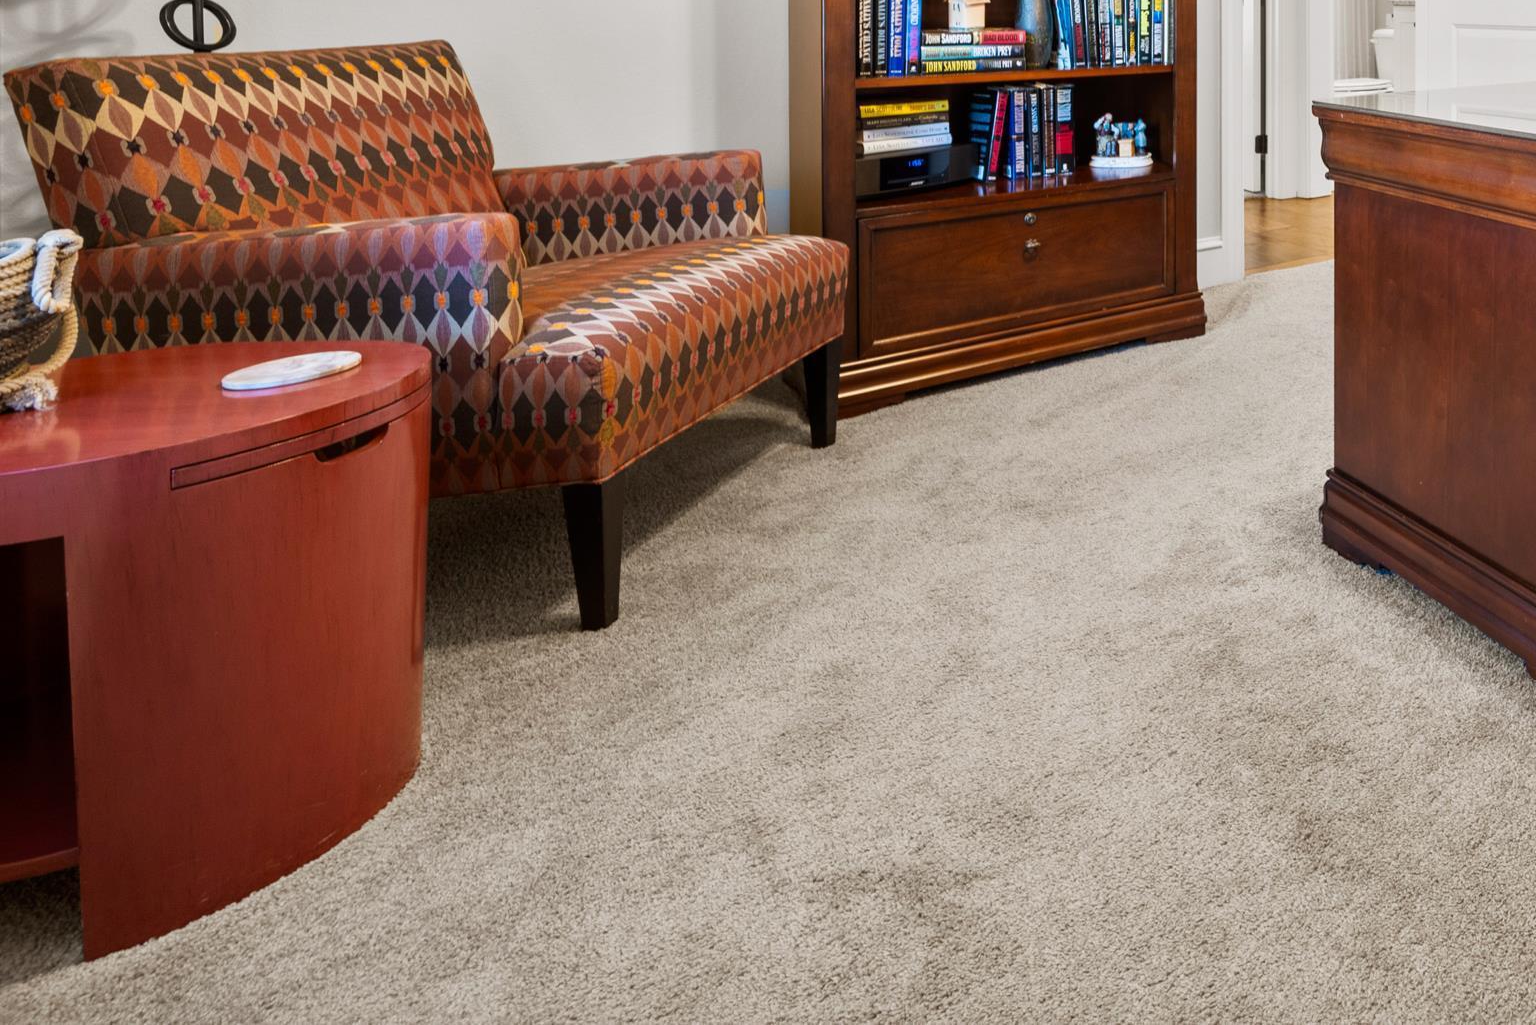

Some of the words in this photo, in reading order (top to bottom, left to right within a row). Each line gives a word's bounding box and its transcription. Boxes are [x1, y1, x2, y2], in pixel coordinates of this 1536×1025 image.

[926, 33, 940, 44] JOHN
[941, 33, 972, 44] SANDFORD
[926, 61, 942, 73] JOHN
[944, 60, 976, 72] SANDFORD
